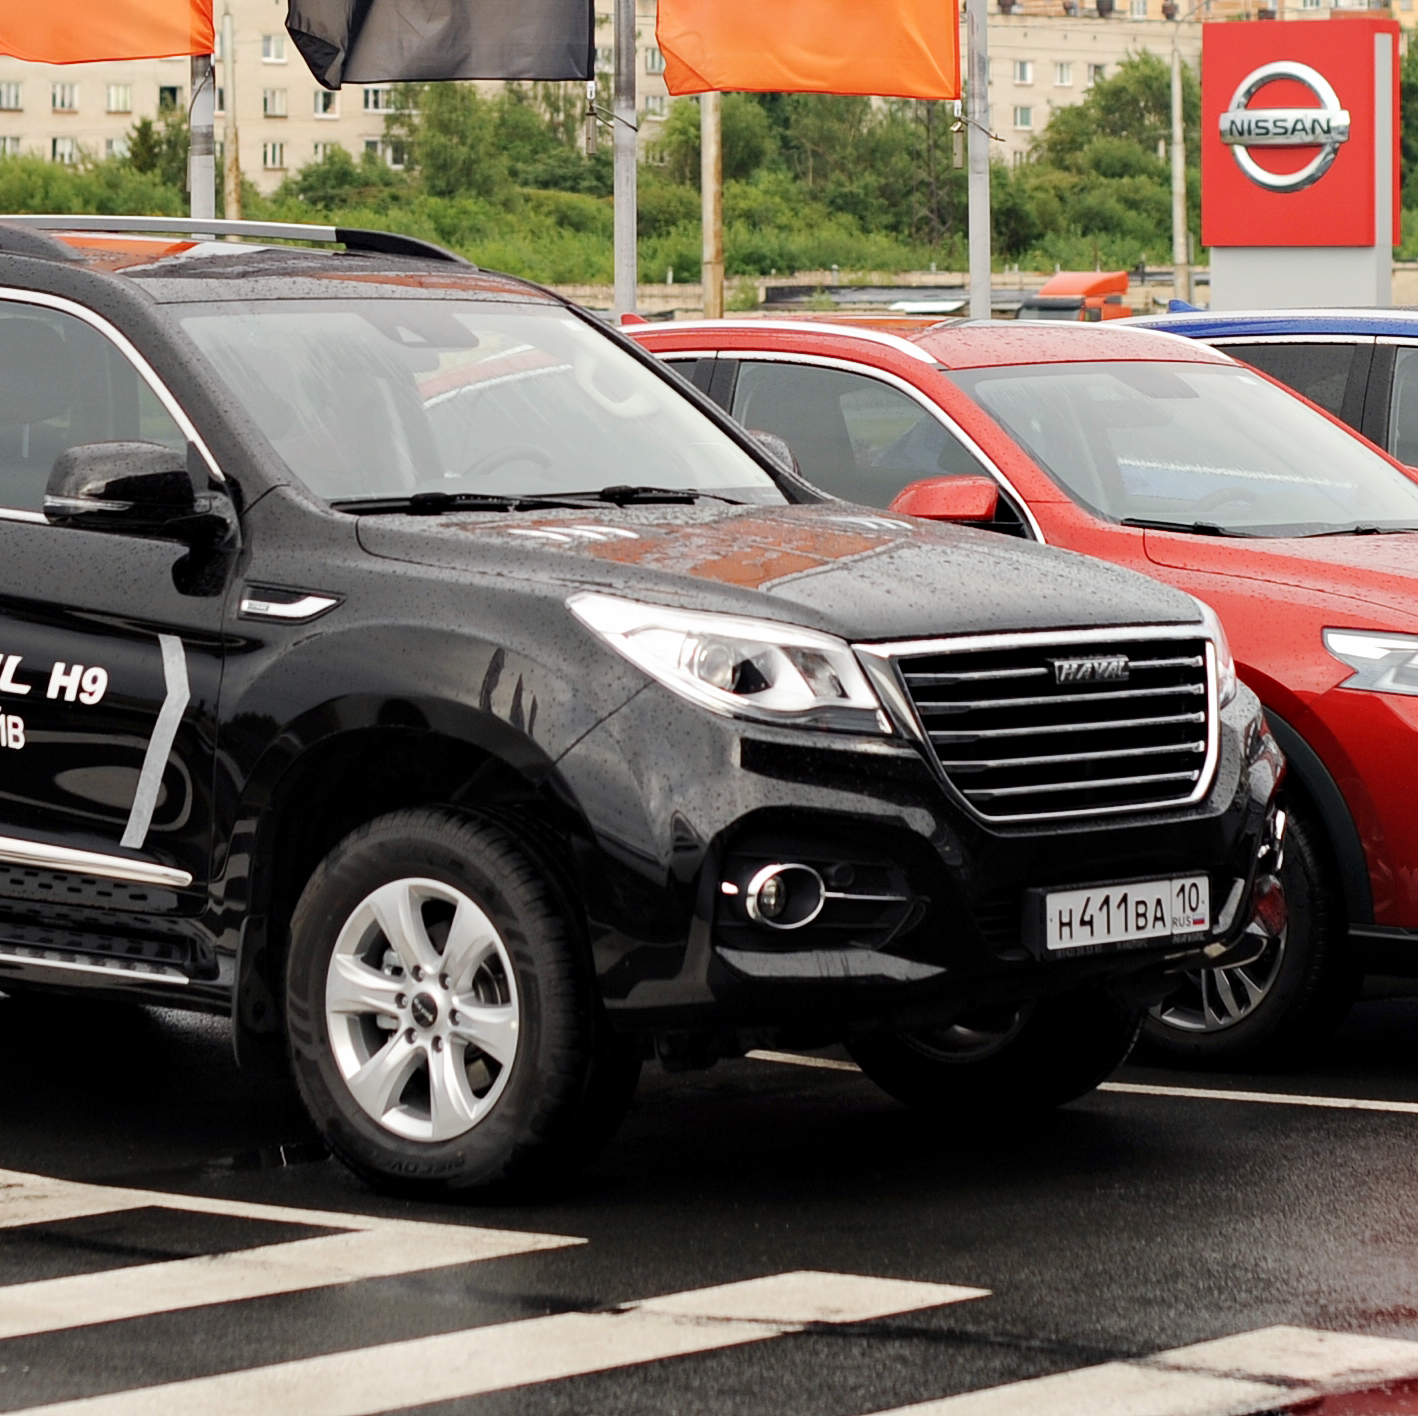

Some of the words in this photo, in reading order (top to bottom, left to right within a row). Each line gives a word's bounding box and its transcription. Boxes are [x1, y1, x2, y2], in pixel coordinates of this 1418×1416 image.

[1229, 118, 1331, 137] NISSAN
[1060, 661, 1129, 682] HAVAL
[47, 662, 108, 705] H9
[1176, 882, 1201, 914] 10
[1172, 915, 1192, 928] RUS
